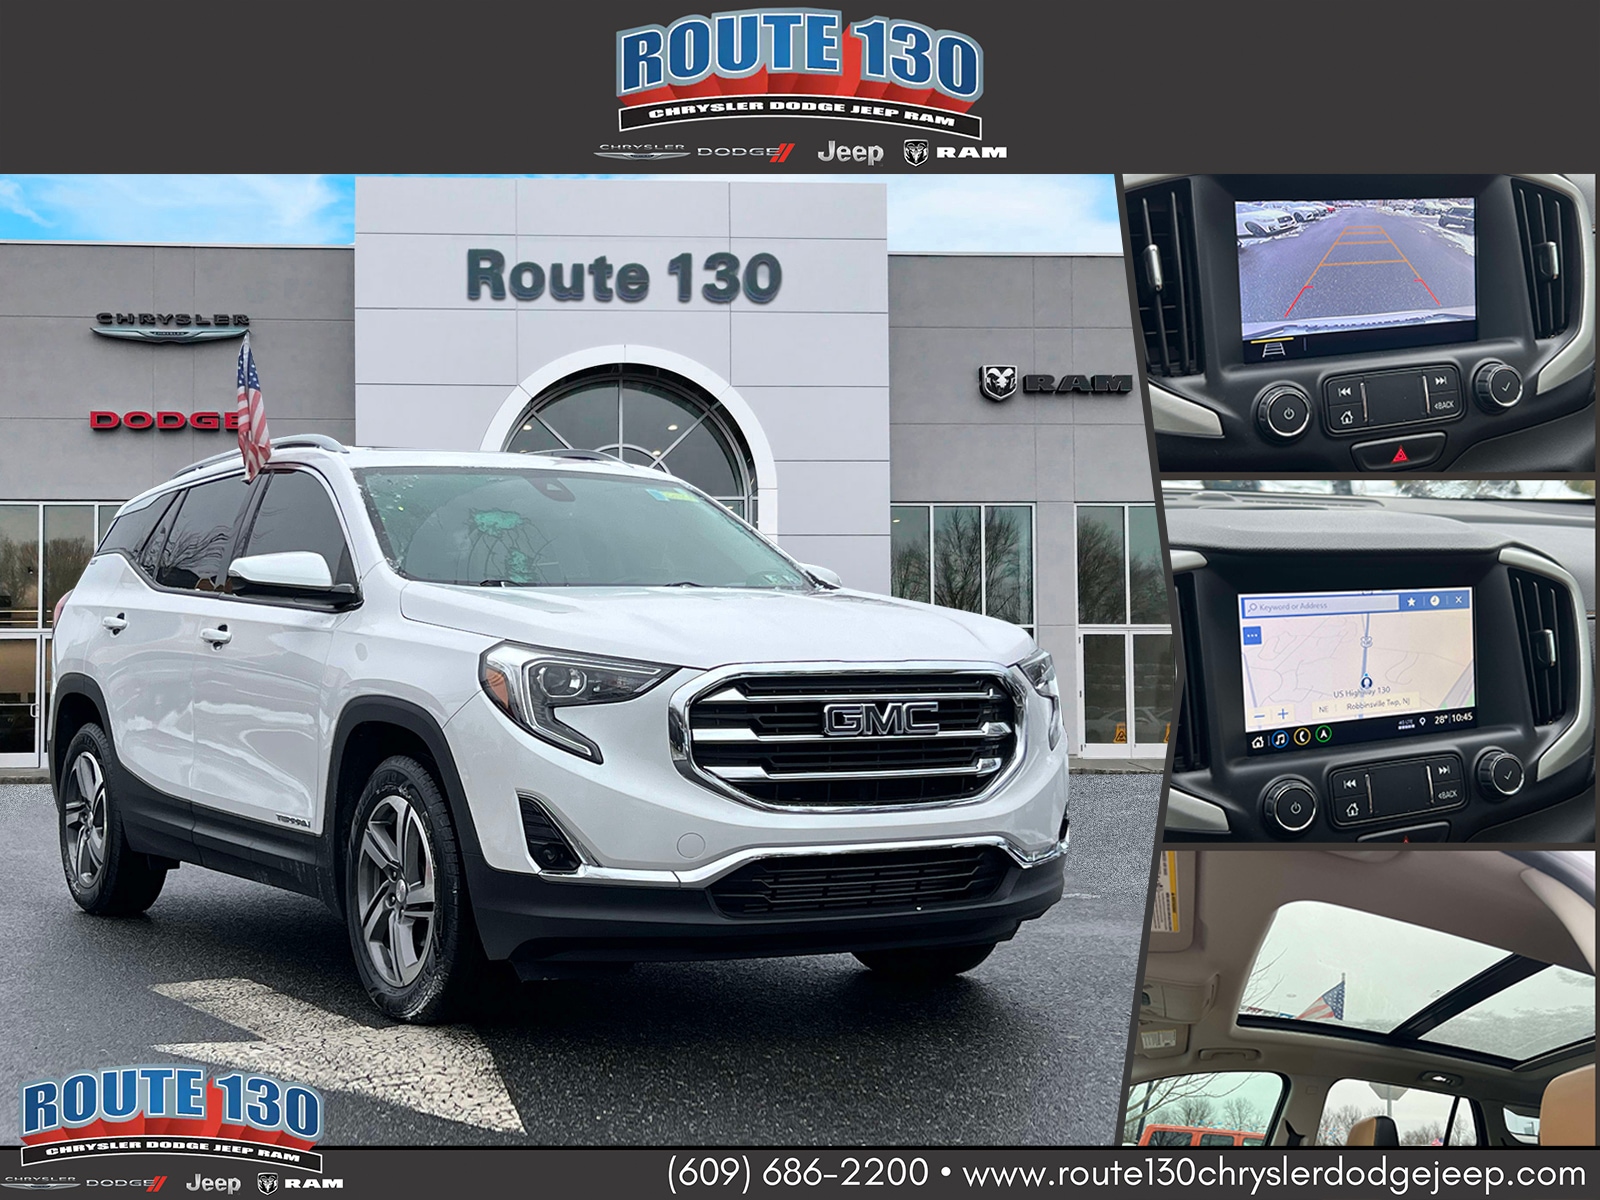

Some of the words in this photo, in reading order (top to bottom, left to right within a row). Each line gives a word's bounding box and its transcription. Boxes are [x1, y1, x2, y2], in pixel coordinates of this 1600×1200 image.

[467, 248, 650, 302] Route
[667, 252, 782, 304] 130
[96, 312, 250, 325] CHRYSLER
[1023, 374, 1133, 394] RAM
[1259, 603, 1290, 612] Keyword
[1300, 602, 1328, 610] Address
[1333, 690, 1344, 698] US
[1377, 686, 1391, 694] 130
[823, 702, 940, 736] GMC
[1452, 712, 1473, 722] 10:45
